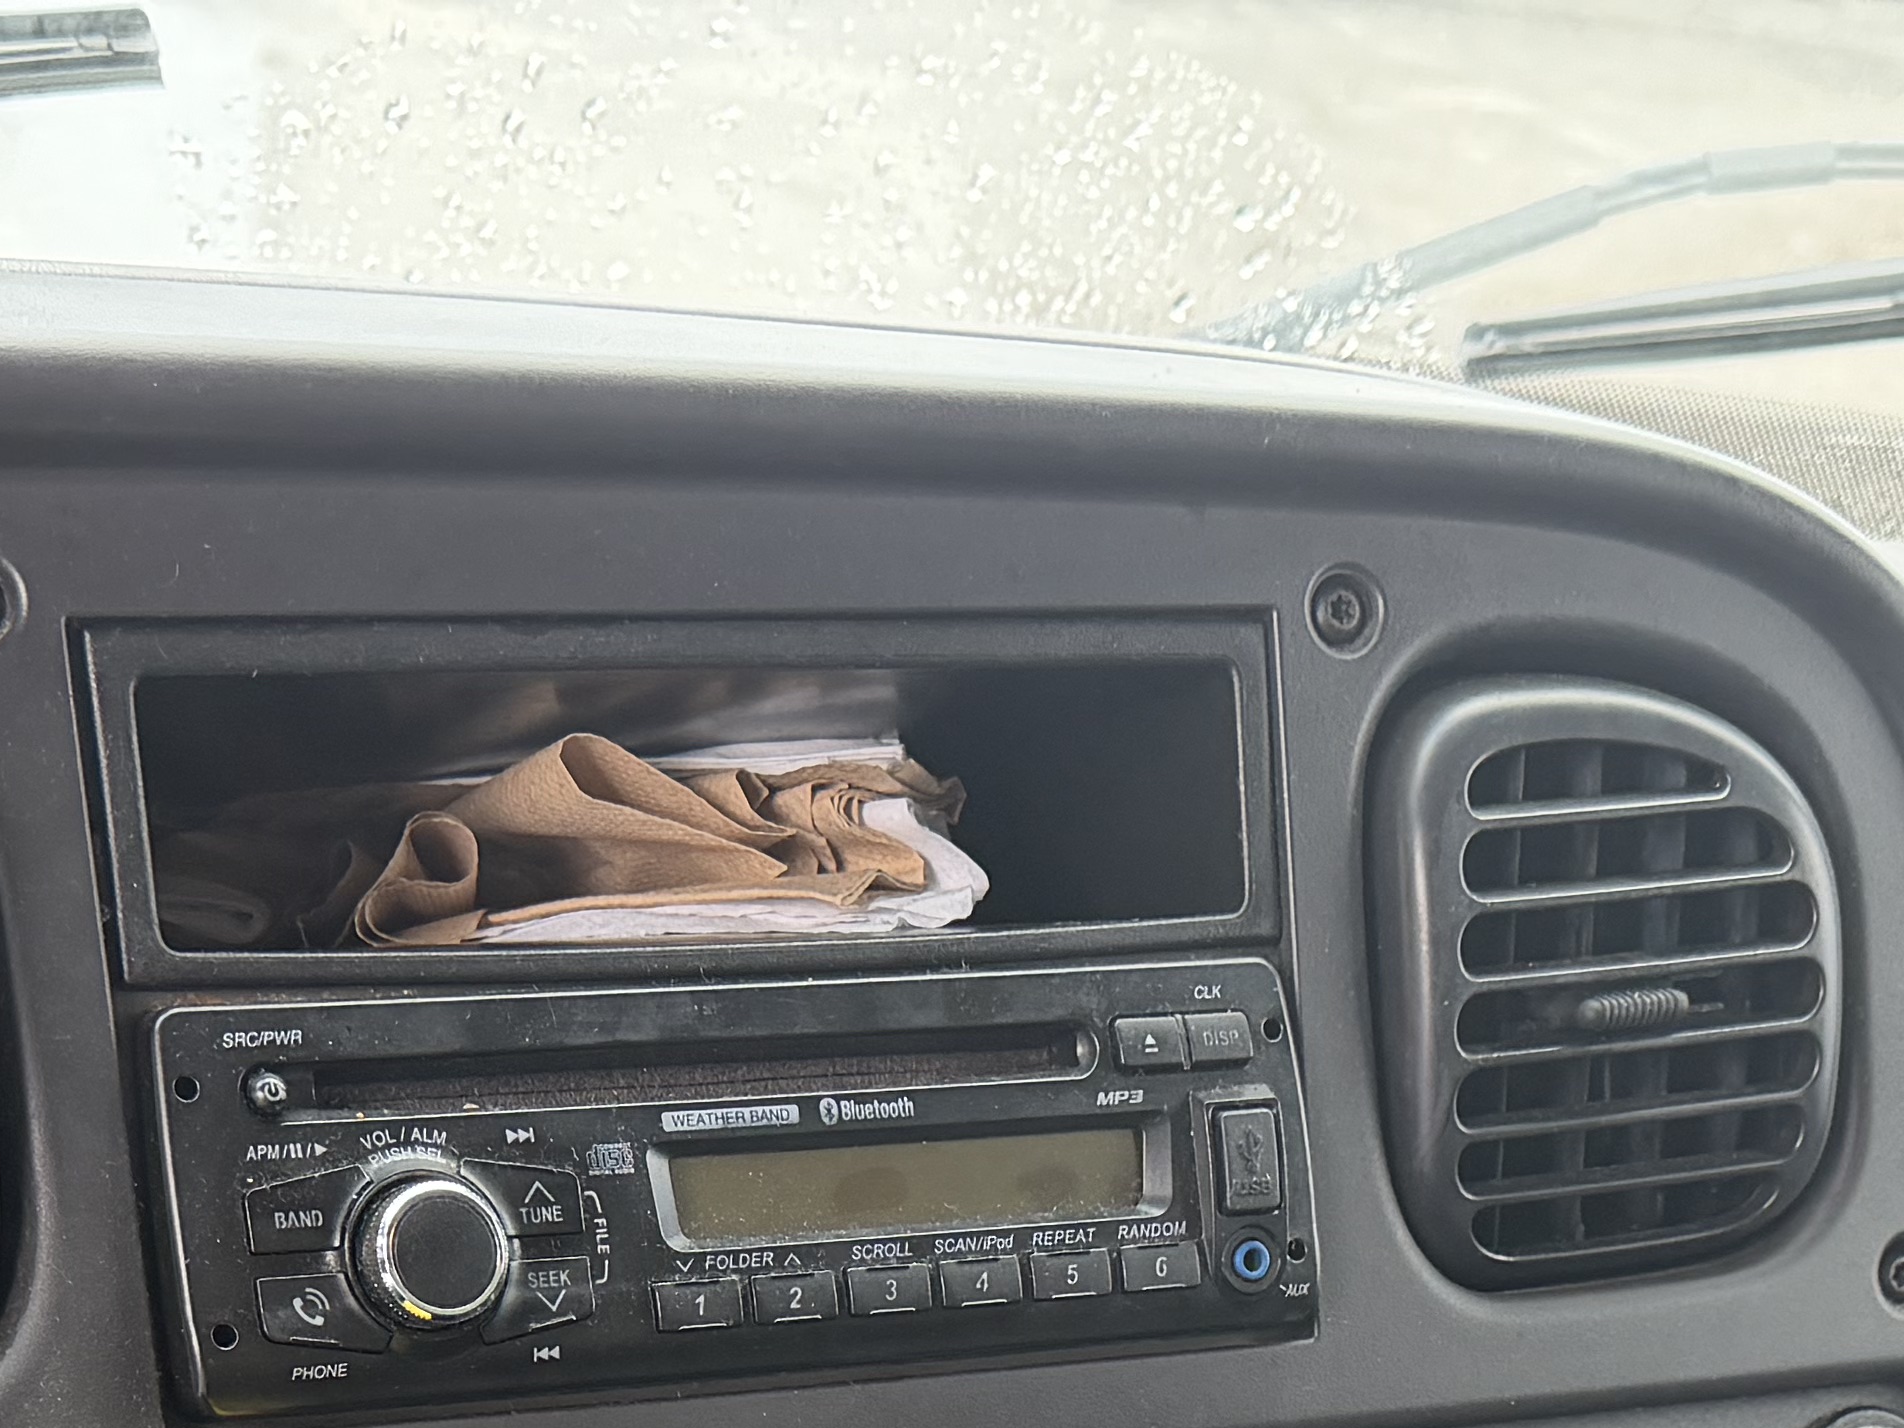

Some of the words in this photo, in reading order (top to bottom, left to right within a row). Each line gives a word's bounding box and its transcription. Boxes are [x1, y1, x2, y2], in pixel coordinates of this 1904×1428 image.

[1194, 985, 1221, 999] CLK
[222, 1029, 304, 1049] SRC/PWR
[1203, 1029, 1239, 1047] DISP
[1097, 1090, 1143, 1106] MP3
[671, 1109, 746, 1128] WEATHER
[749, 1106, 791, 1125] BAND
[840, 1097, 915, 1122] Bluetooth
[360, 1129, 397, 1150] VOL
[368, 1145, 412, 1166] PUSH
[274, 1209, 323, 1230] BAND
[519, 1205, 564, 1224] TUNE
[593, 1218, 611, 1255] FILE
[1033, 1227, 1097, 1247] REPEAT
[1117, 1220, 1187, 1240] RANDOM
[851, 1243, 915, 1261] SCROLL
[934, 1234, 1015, 1255] SCAN/iPod
[705, 1252, 774, 1271] FOLDER
[1155, 1256, 1167, 1277] 6
[527, 1269, 572, 1288] SEEK
[975, 1271, 989, 1292] 4
[1067, 1264, 1079, 1285] 5
[789, 1286, 802, 1309] 2
[885, 1279, 897, 1301] 3
[695, 1294, 705, 1316] 1
[292, 1363, 348, 1382] PHONE
